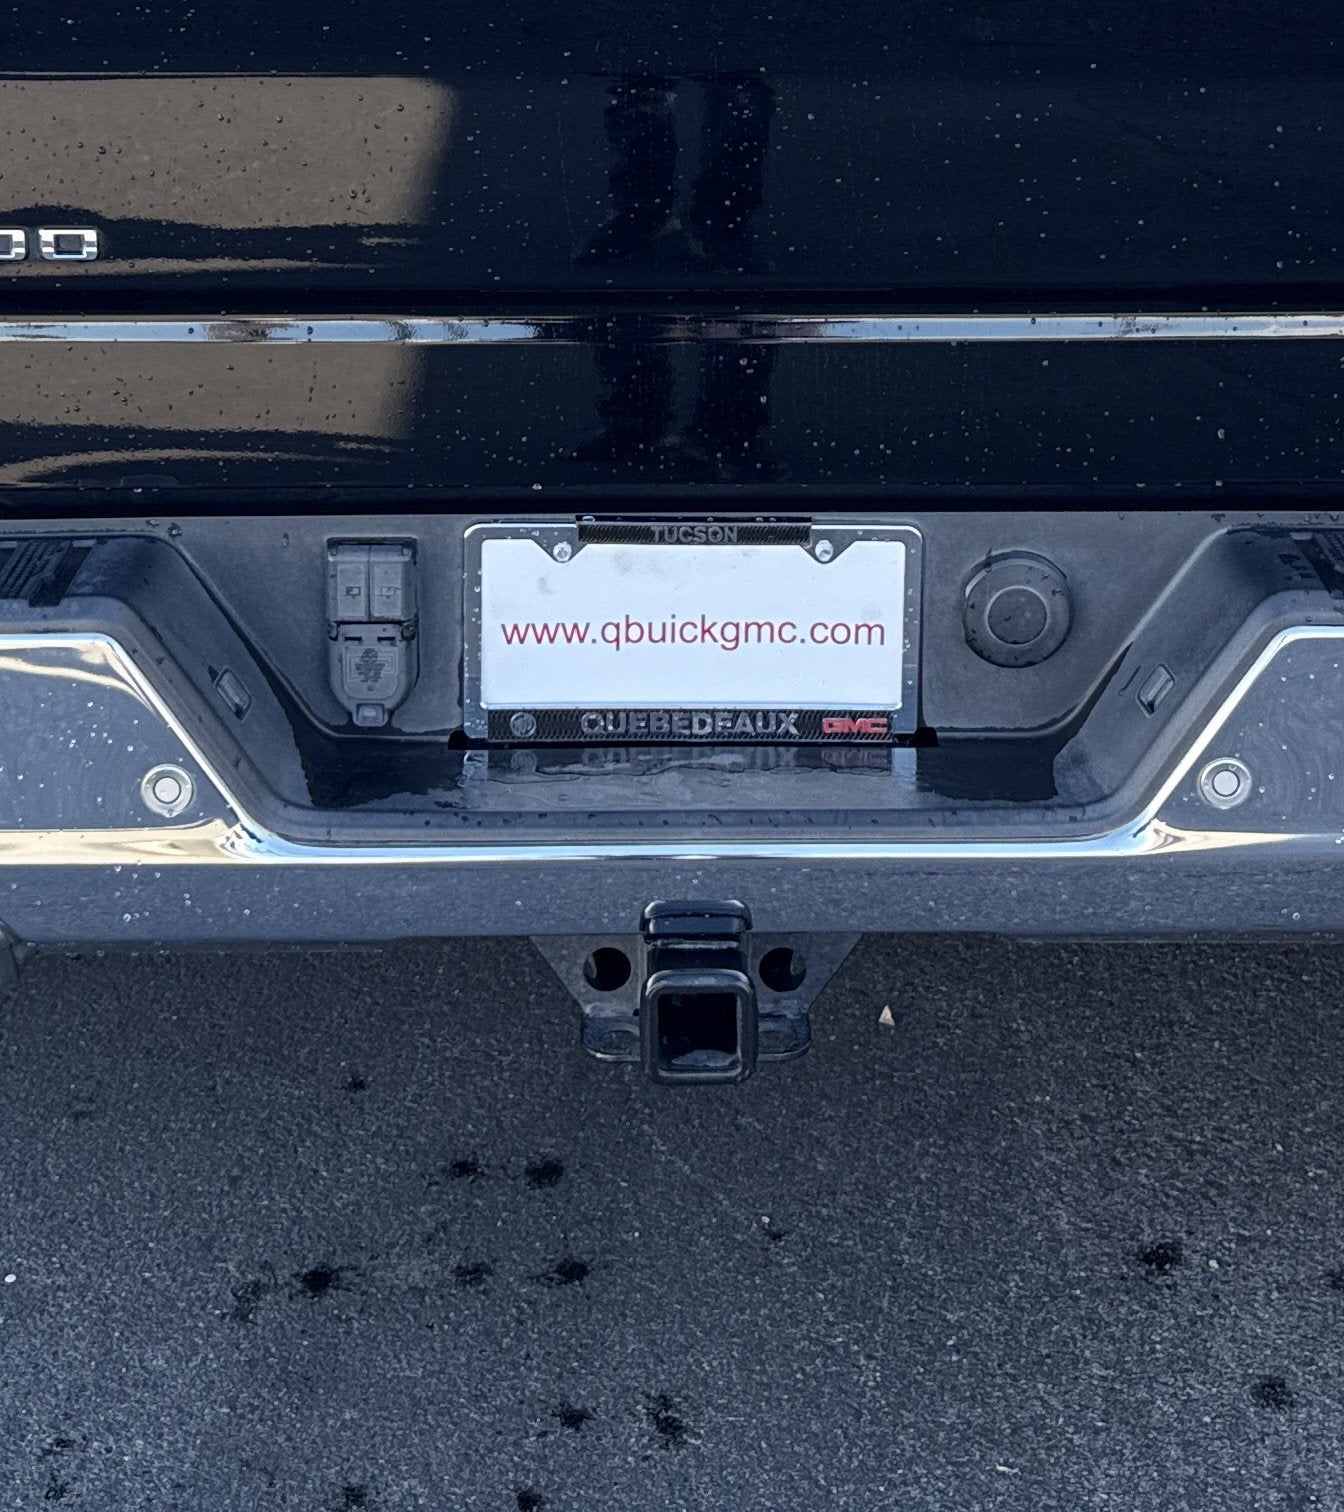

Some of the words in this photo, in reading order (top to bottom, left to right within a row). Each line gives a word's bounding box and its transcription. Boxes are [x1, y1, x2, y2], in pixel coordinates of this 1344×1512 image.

[650, 525, 738, 544] TUCSON
[501, 613, 886, 652] www.qbuickgmc.com
[580, 711, 800, 736] QUEBEDEAUX
[822, 717, 888, 735] GMC
